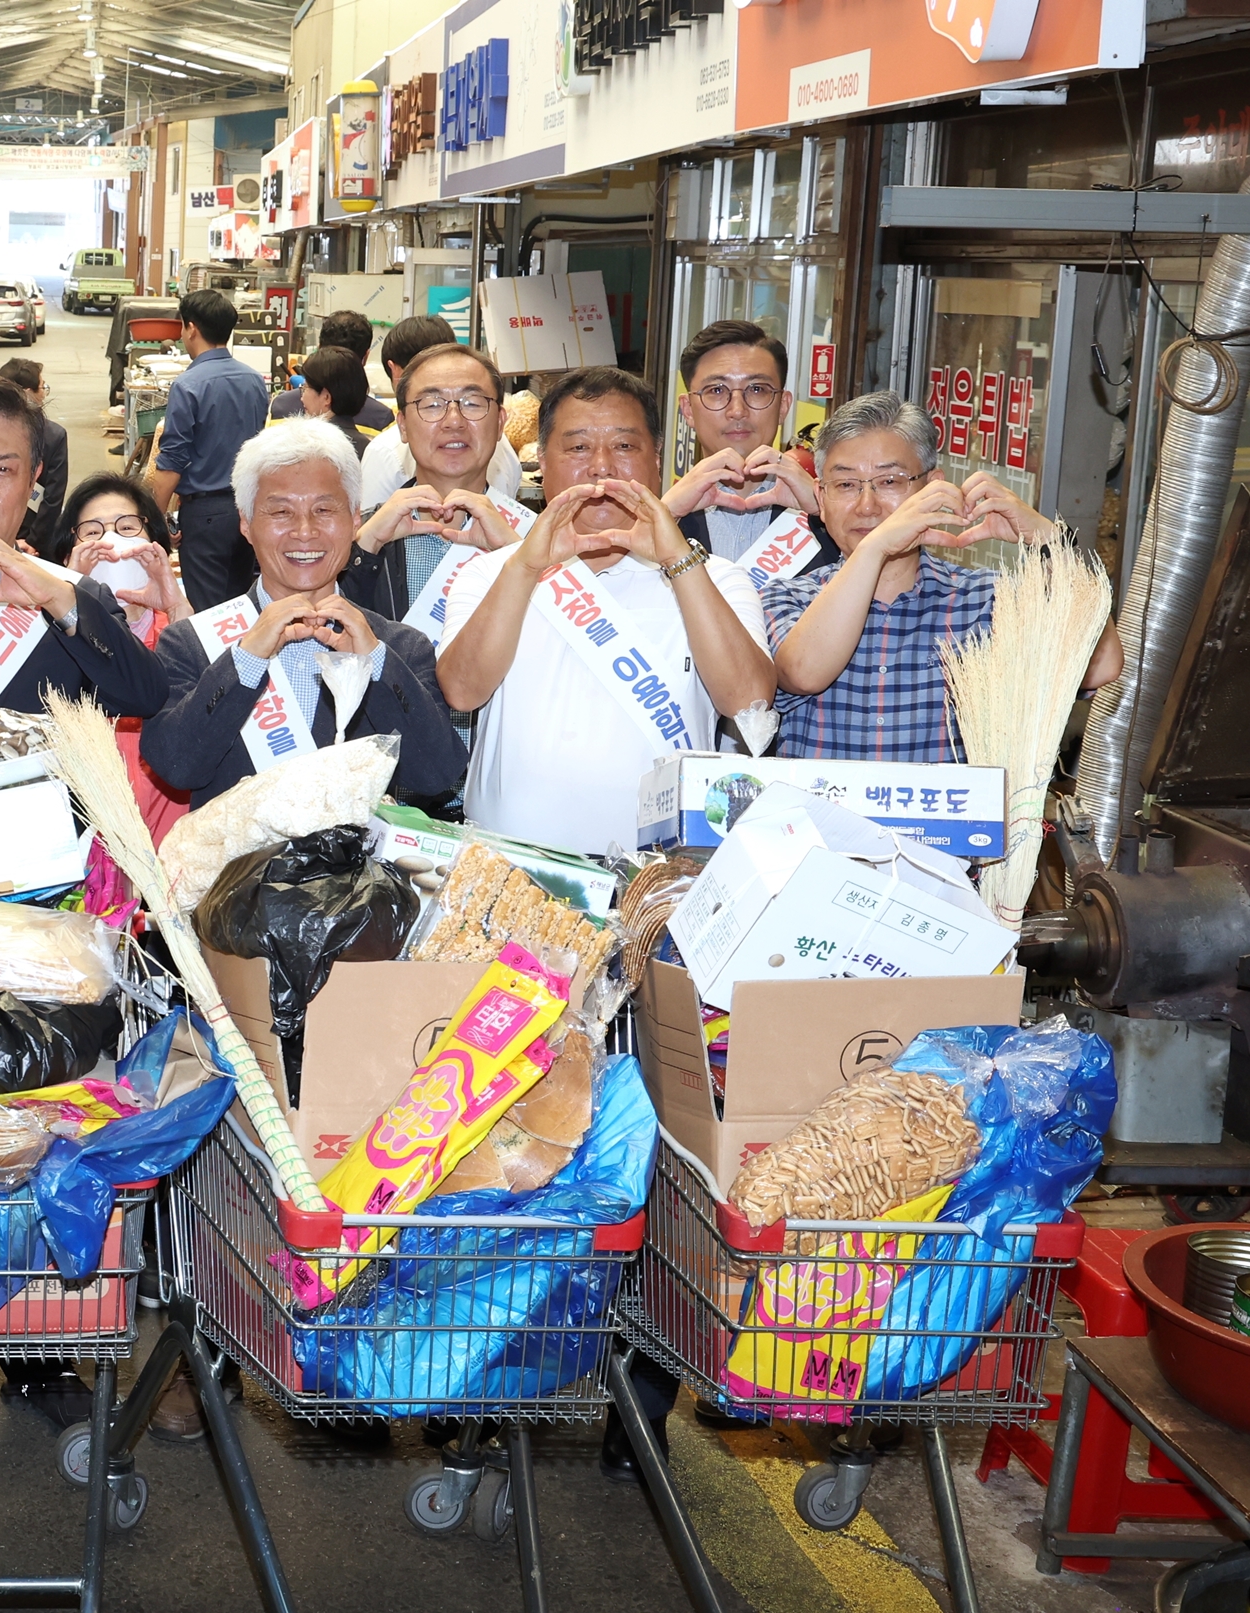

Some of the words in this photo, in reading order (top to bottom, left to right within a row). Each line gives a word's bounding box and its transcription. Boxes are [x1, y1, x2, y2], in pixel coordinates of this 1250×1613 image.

[797, 72, 859, 107] 010-4600-0680
[509, 315, 544, 329] 택배용
[812, 372, 833, 382] 소화기
[865, 785, 971, 814] 백구포도
[972, 835, 989, 845] 3kg
[794, 935, 838, 962] 황산
